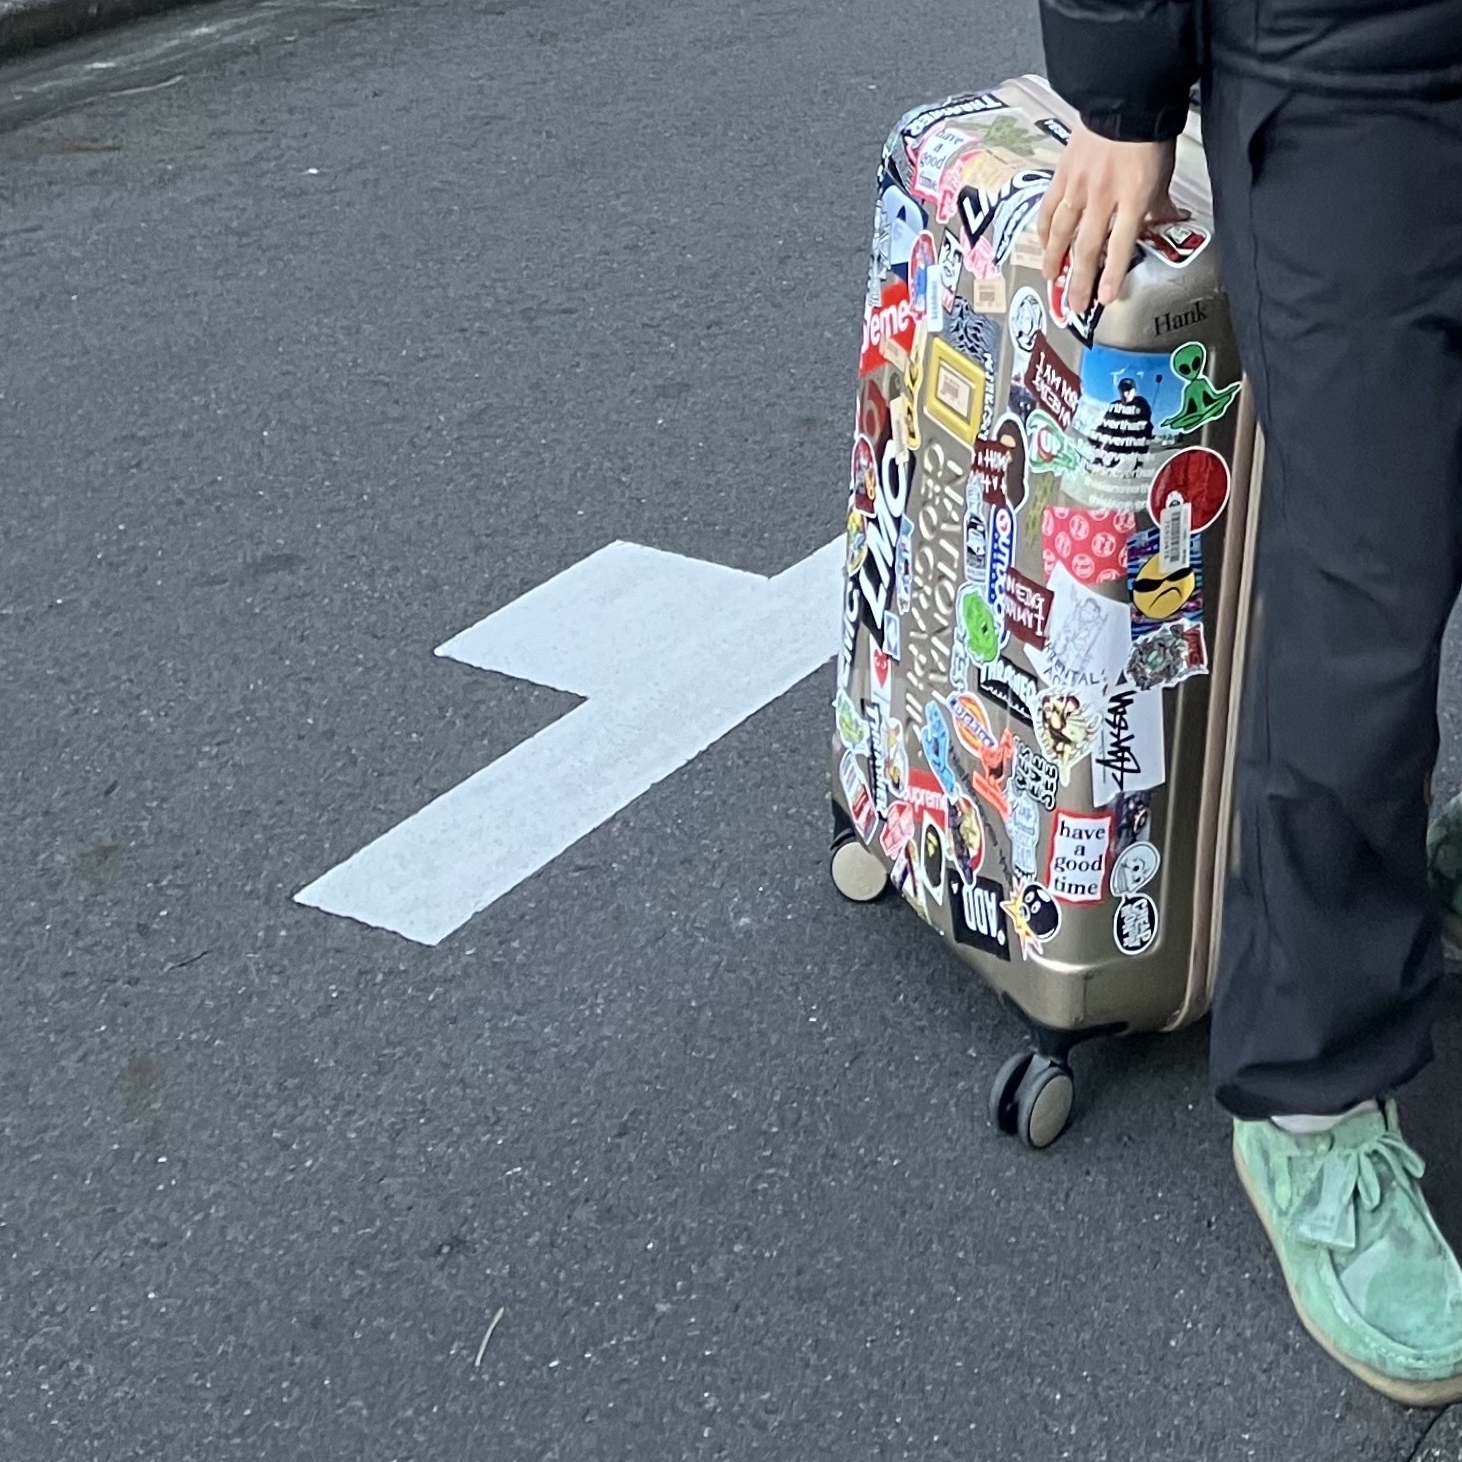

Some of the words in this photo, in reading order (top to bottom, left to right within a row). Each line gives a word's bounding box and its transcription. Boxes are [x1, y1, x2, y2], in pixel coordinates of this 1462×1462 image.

[1154, 301, 1209, 337] Hank
[1059, 820, 1106, 840] have
[1073, 844, 1086, 857] a
[1053, 853, 1103, 873] good
[1053, 876, 1099, 896] time
